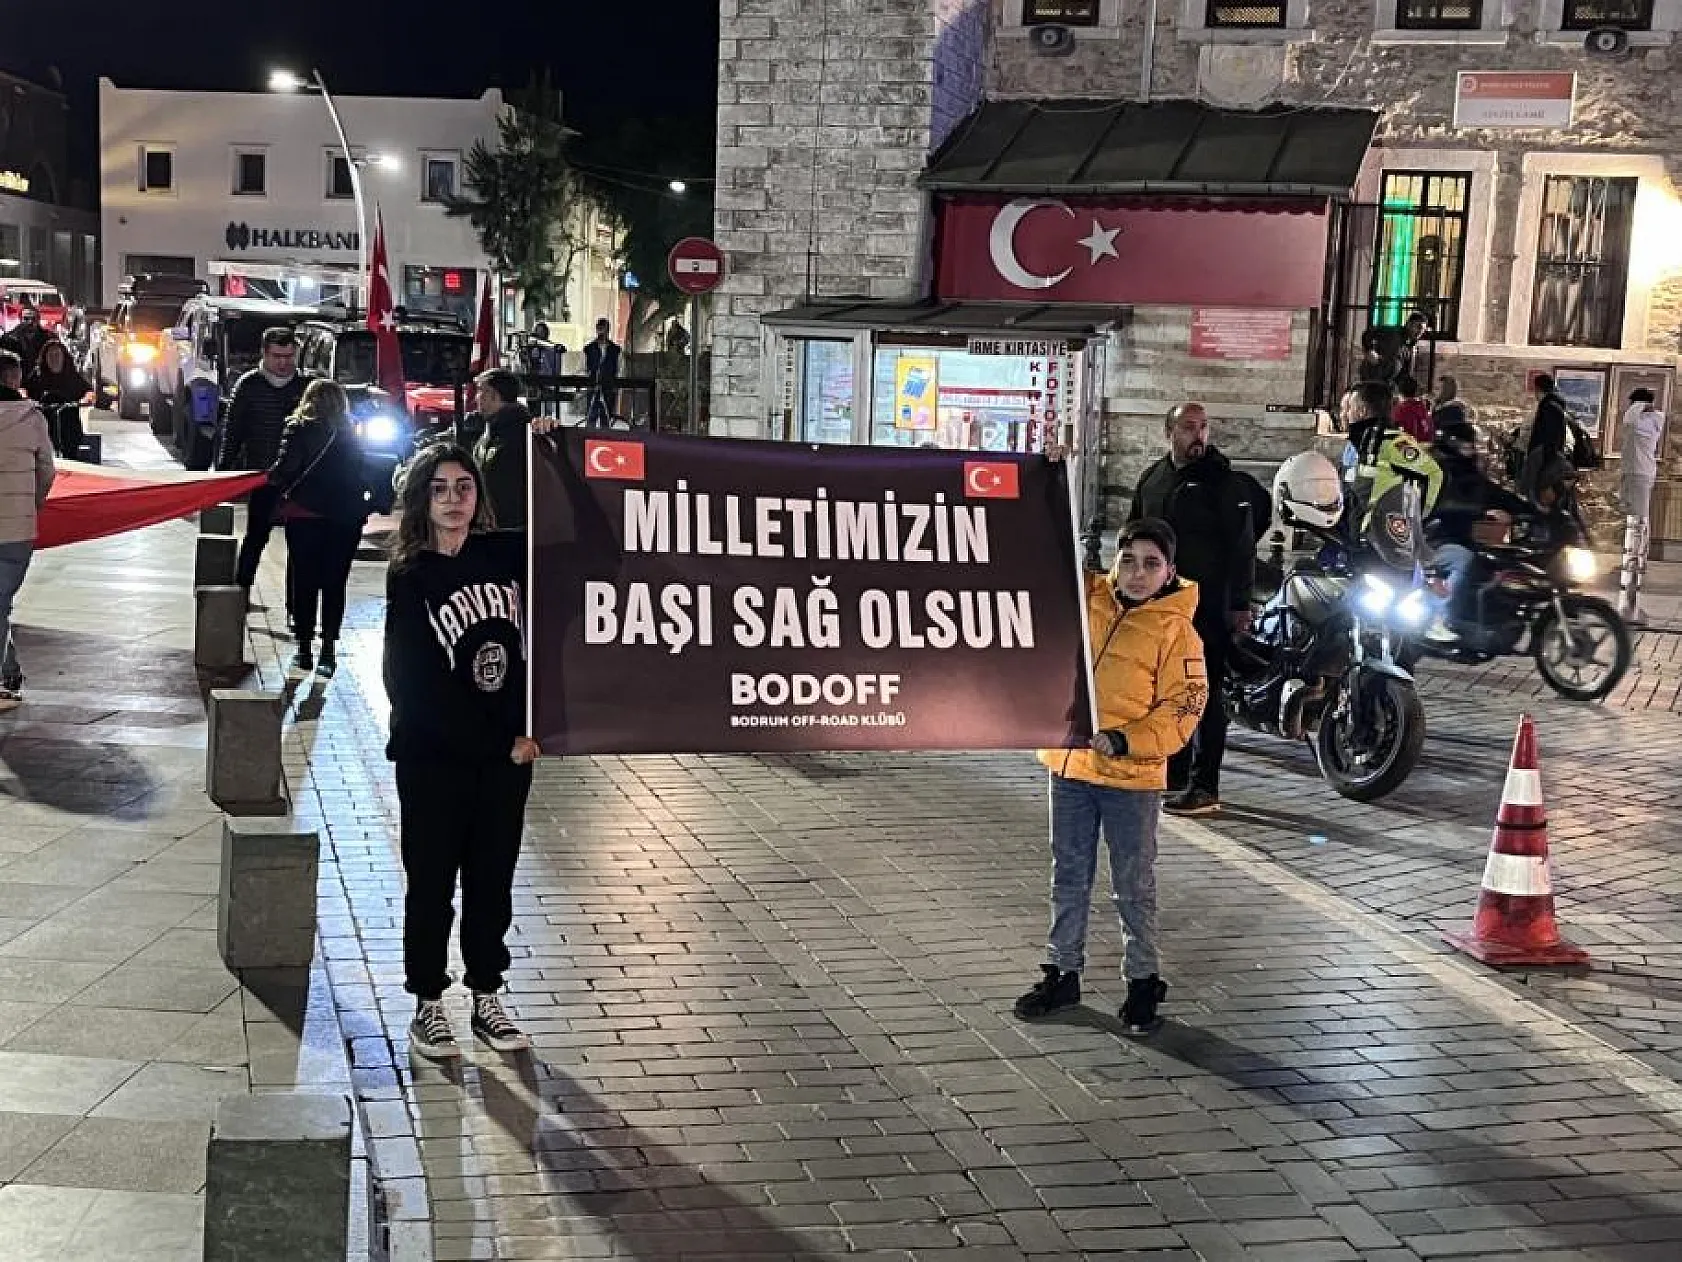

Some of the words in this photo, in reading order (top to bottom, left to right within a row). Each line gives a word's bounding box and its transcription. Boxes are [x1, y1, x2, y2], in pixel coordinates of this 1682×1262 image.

[623, 479, 989, 563] MİLLETİMİZİN
[584, 580, 713, 654] BAŞI
[733, 574, 841, 649] SAĞ
[859, 588, 1036, 649] OLSUN
[731, 673, 901, 706] BODOFF
[730, 715, 789, 727] BODRUM
[792, 715, 859, 727] OFF-ROAD
[861, 711, 906, 727] KLÜBÜ
